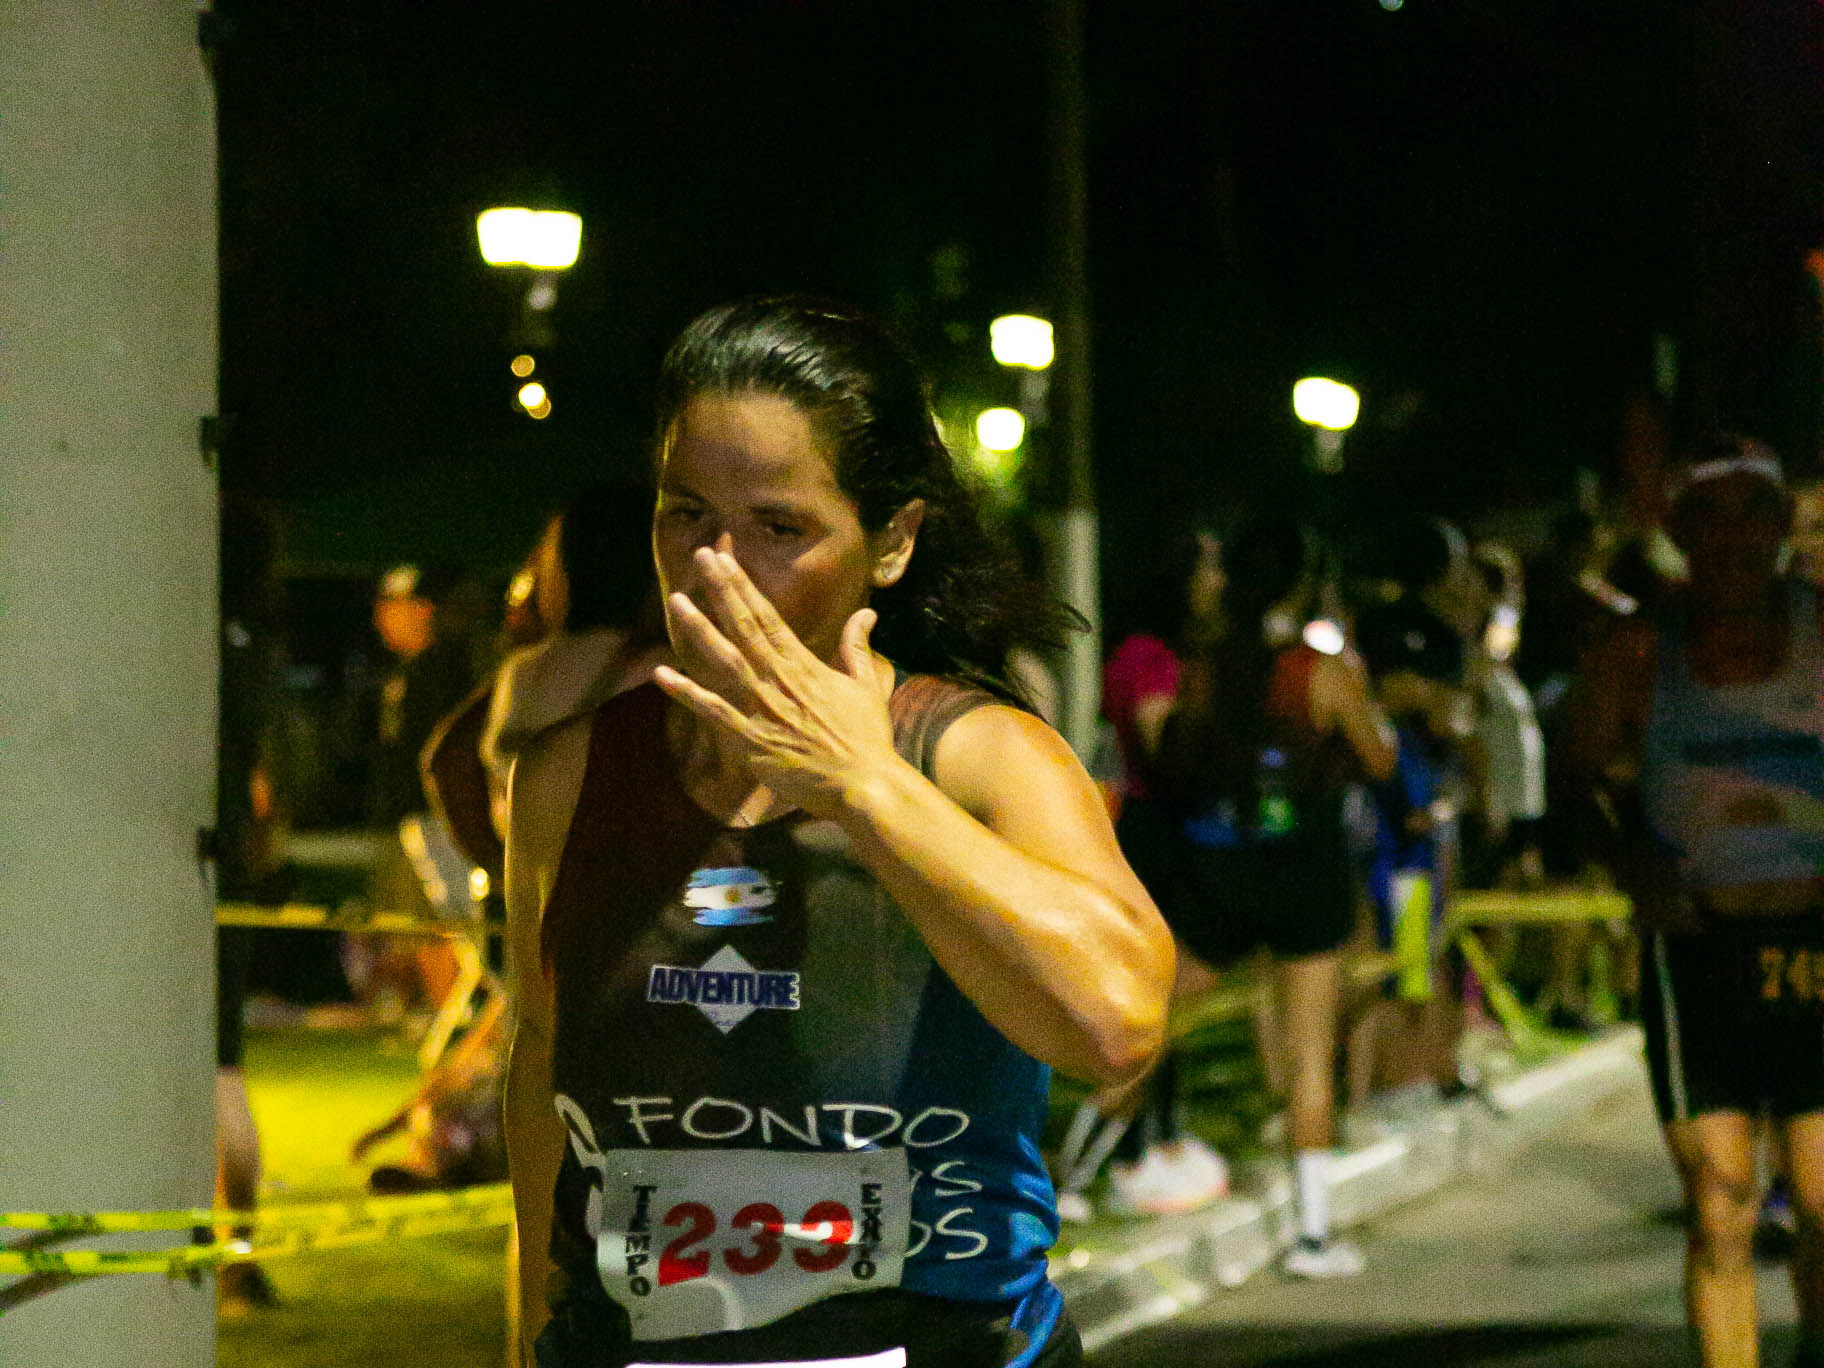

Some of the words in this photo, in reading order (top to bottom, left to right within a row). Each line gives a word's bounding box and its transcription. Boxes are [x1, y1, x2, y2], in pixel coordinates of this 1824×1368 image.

[650, 966, 799, 1008] ADVENTURE
[613, 1096, 970, 1149] FONDO
[657, 1200, 855, 1286] 233
